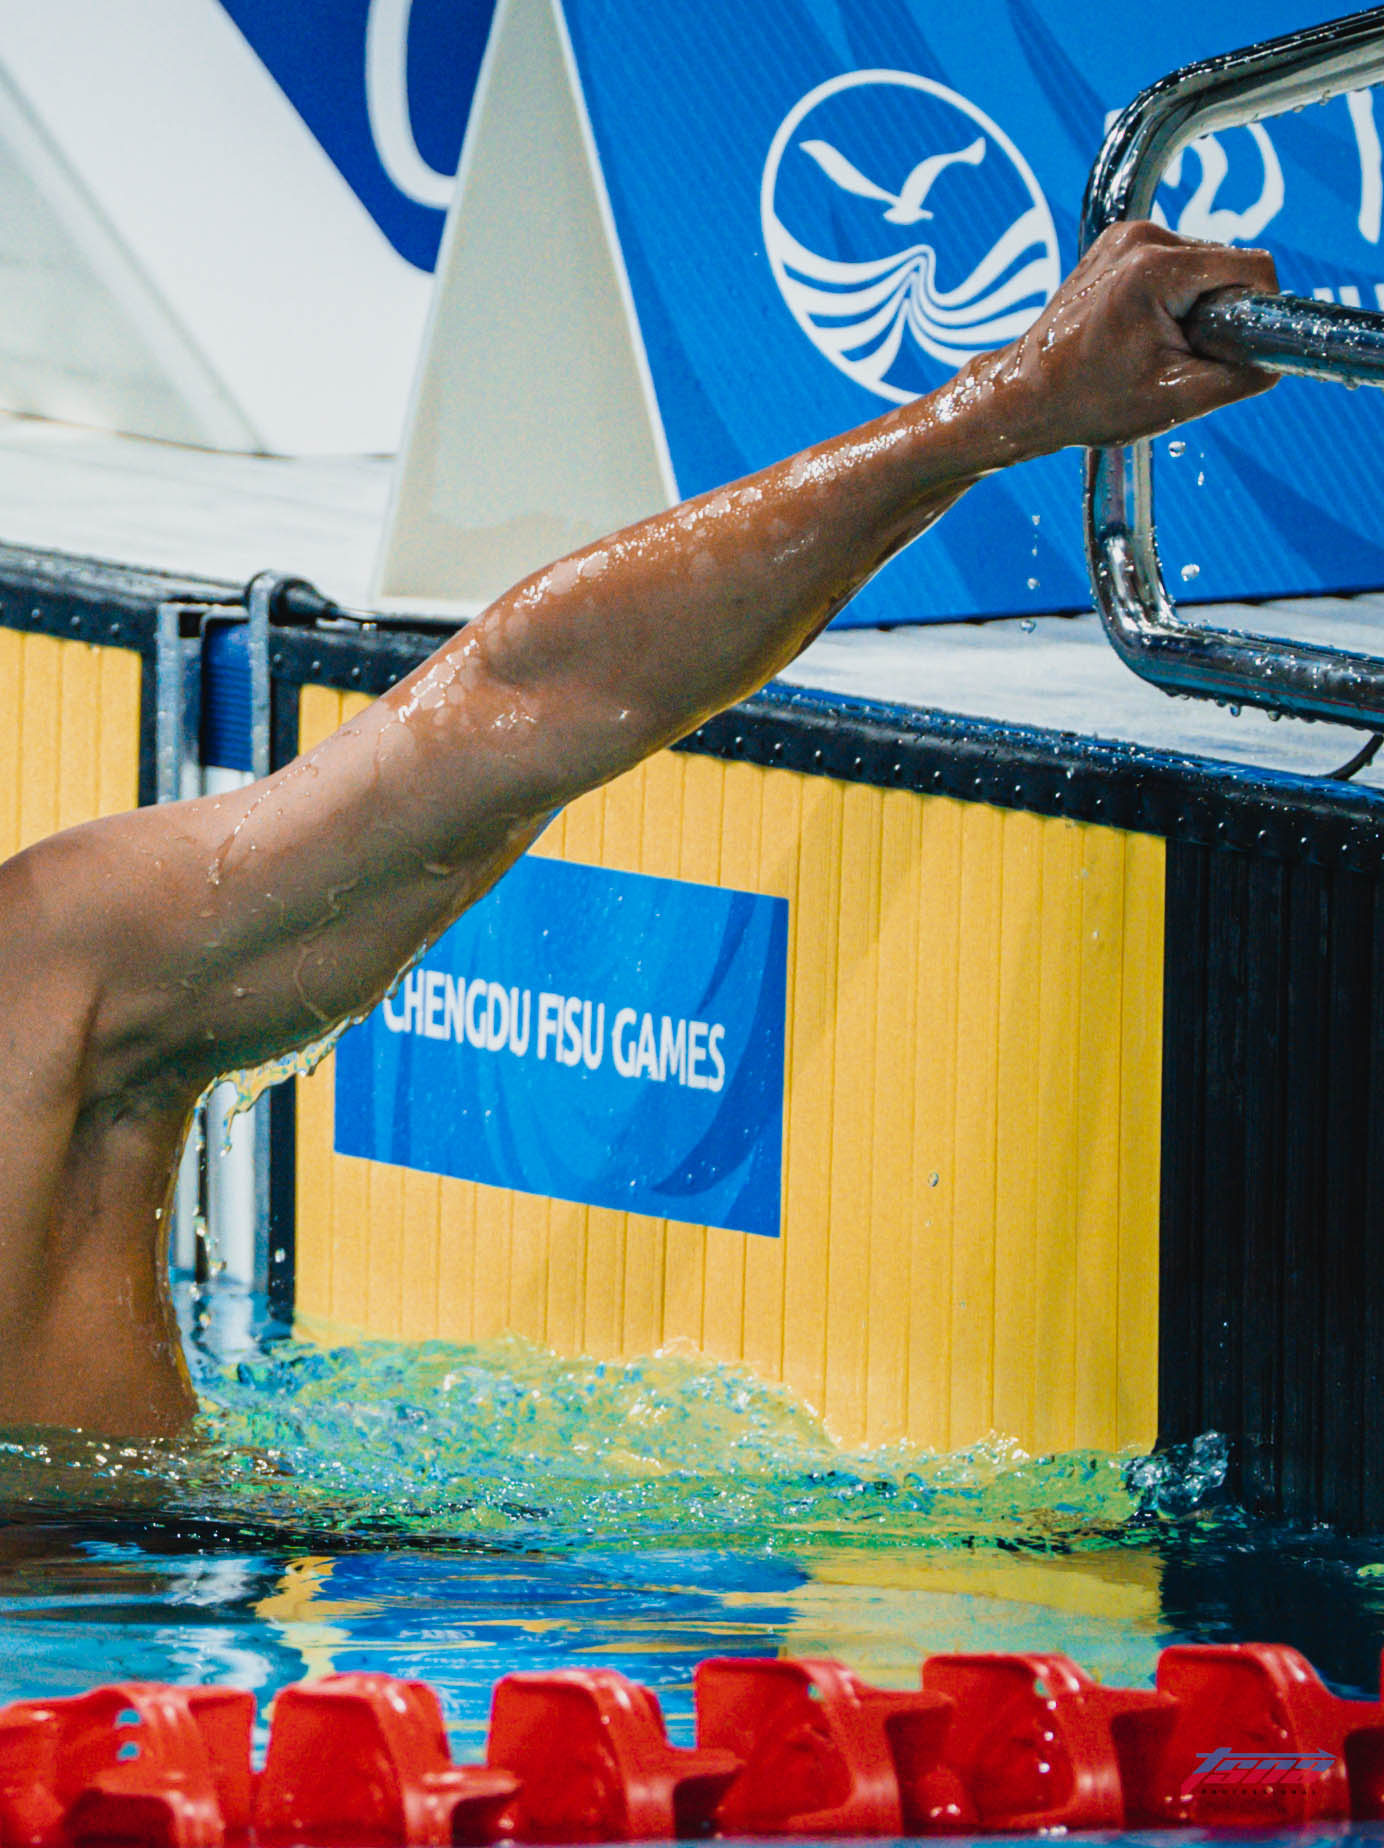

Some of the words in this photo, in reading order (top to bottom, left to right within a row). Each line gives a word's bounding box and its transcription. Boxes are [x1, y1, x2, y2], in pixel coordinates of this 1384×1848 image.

[383, 968, 531, 1057] CHENGDU
[537, 992, 605, 1070] FISU
[612, 1007, 726, 1093] GAMES
